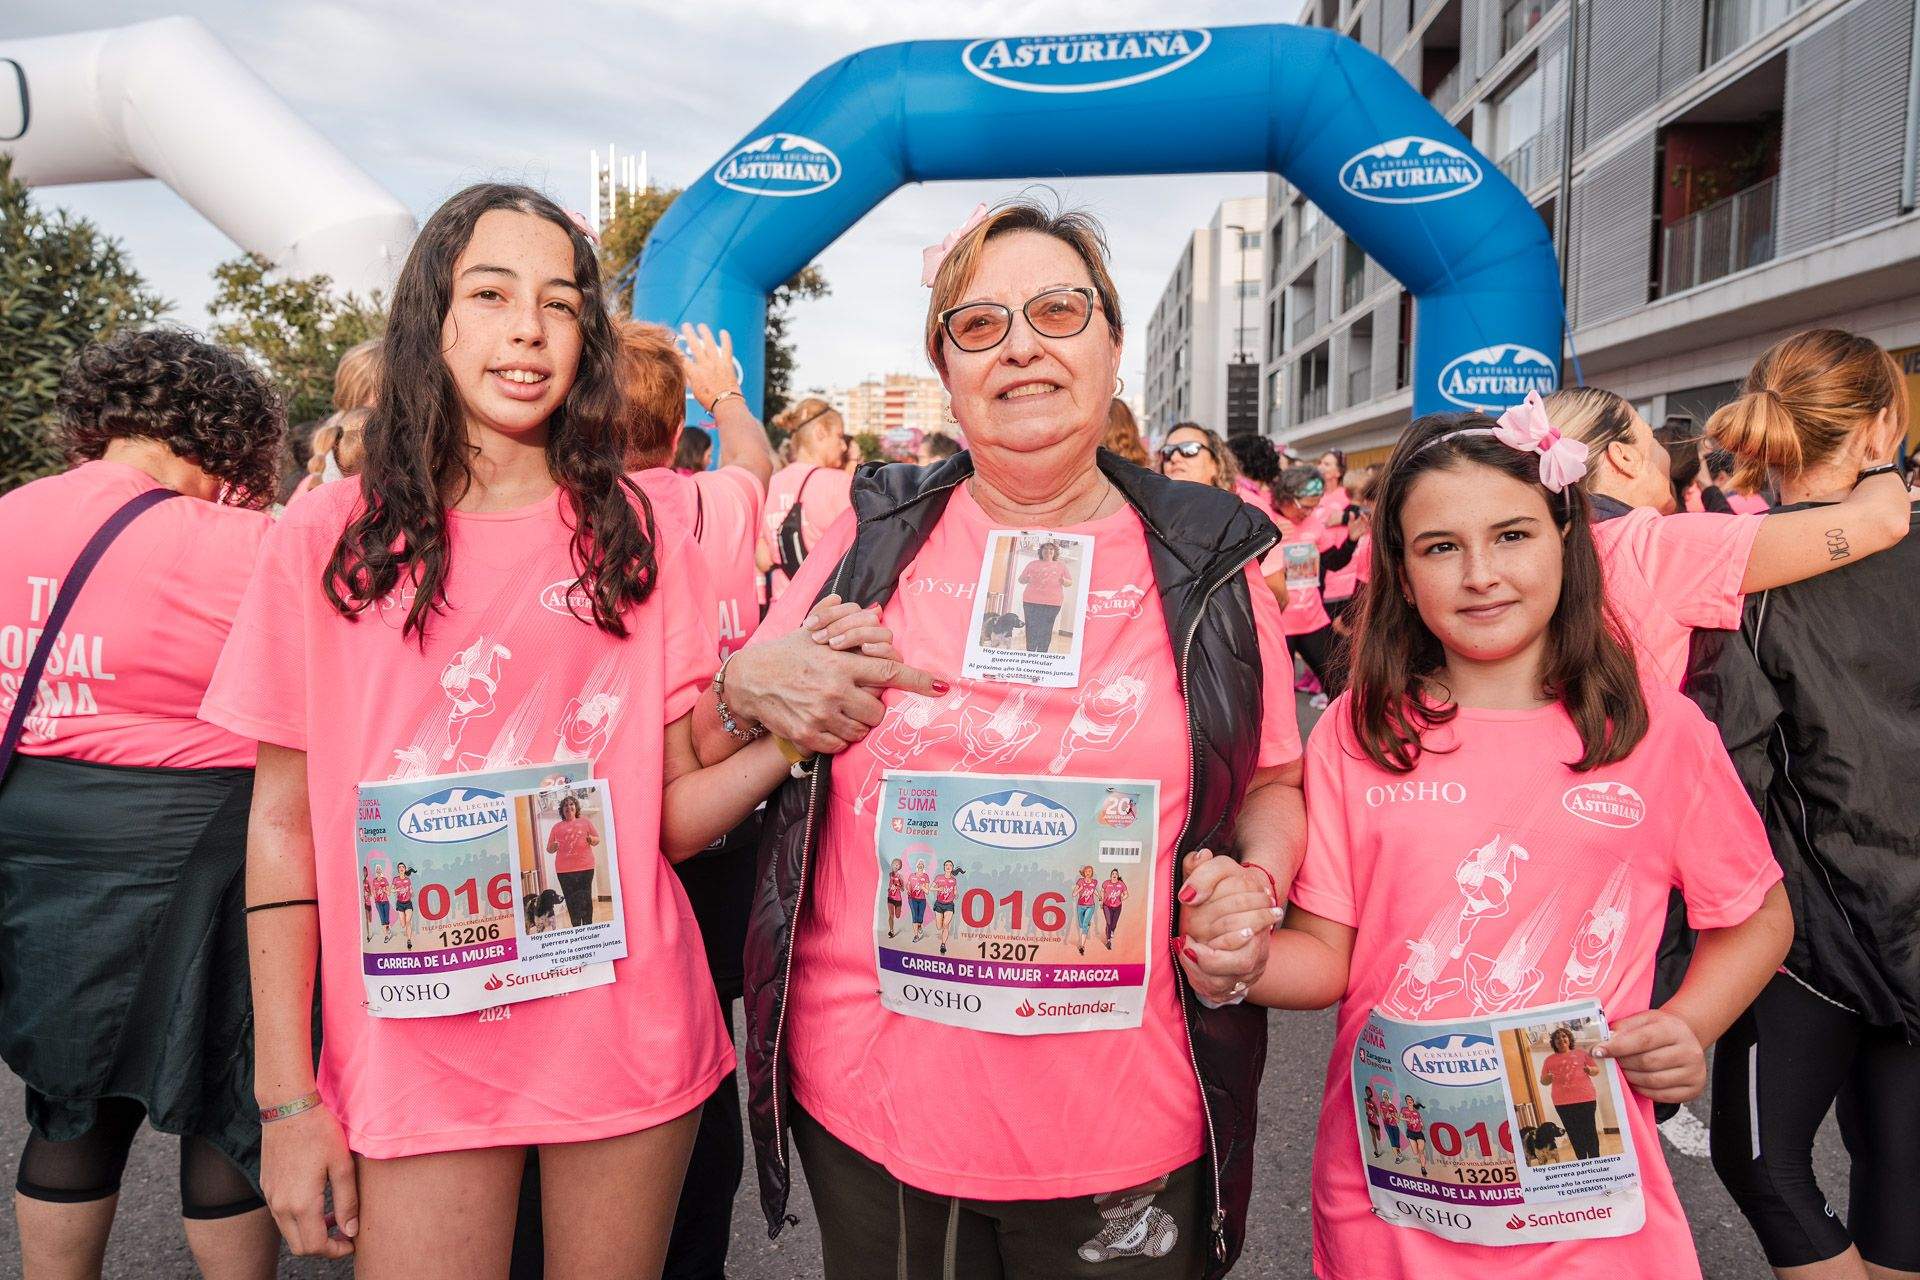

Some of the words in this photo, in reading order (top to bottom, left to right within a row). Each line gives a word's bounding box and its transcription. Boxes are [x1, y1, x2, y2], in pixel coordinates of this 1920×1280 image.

[979, 36, 1192, 69] ASTURIANA
[721, 158, 830, 182] ASTURIANA
[1350, 163, 1474, 189] ASTURIANA
[1020, 659, 1053, 667] particular
[0, 672, 99, 718] SMA
[898, 788, 909, 797] TU
[912, 789, 937, 797] DORSAL
[1366, 781, 1467, 807] OYSHO
[423, 806, 464, 816] CENTRAL
[466, 800, 506, 810] LECHERA
[898, 797, 936, 811] SUMA
[980, 808, 1021, 817] CENTRAL
[1024, 810, 1065, 818] LECHERA
[1570, 793, 1641, 820] ASTURIANA
[407, 808, 508, 834] ASTURIANA
[907, 818, 939, 828] Zaragoza
[961, 809, 1068, 836] ASTURIANA
[906, 827, 938, 836] DEPORTE
[418, 873, 513, 920] 016
[961, 888, 1066, 932] 016
[439, 923, 500, 947] 13206
[531, 933, 543, 942] Hoy
[544, 929, 574, 939] corremos
[575, 927, 586, 935] por
[587, 923, 611, 932] nuestra
[541, 939, 569, 949] guerrera
[570, 933, 600, 944] particular
[377, 957, 421, 970] CARRERA
[424, 956, 439, 968] DE
[443, 954, 459, 965] LA
[462, 944, 505, 963] MUJER
[529, 952, 554, 962] próximo
[574, 943, 602, 953] corremos
[559, 953, 593, 963] QUEREMOS
[977, 941, 1039, 961] 13207
[901, 957, 955, 975] CARRERA
[958, 966, 974, 978] DE
[978, 967, 994, 979] LA
[998, 968, 1042, 982] MUJER
[1053, 969, 1120, 982] ZARAGOZA
[381, 983, 450, 1002] OYSHO
[903, 984, 981, 1012] OYSHO
[1037, 1001, 1115, 1017] Santander
[479, 1006, 511, 1023] 2024
[1411, 1053, 1499, 1074] ASTURIAN
[1424, 1051, 1463, 1059] CENTRAL
[1467, 1048, 1496, 1056] LECHE
[1545, 1172, 1575, 1181] guerrera
[1576, 1166, 1610, 1177] particular
[1548, 1162, 1581, 1171] corremos
[1581, 1160, 1593, 1168] por
[1595, 1156, 1621, 1164] nuestra
[1455, 1167, 1516, 1184] 13205
[1533, 1183, 1560, 1193] próximo
[1561, 1180, 1574, 1188] año
[1582, 1176, 1614, 1185] corremos
[1614, 1172, 1637, 1182] juntas.
[1389, 1176, 1439, 1196] CARRERA
[1442, 1186, 1458, 1199] DE
[1461, 1189, 1477, 1200] LA
[1480, 1188, 1523, 1201] MUJER
[1567, 1185, 1603, 1196] QUEREMOS
[1396, 1200, 1472, 1229] OYSHO
[1528, 1206, 1612, 1227] Santander
